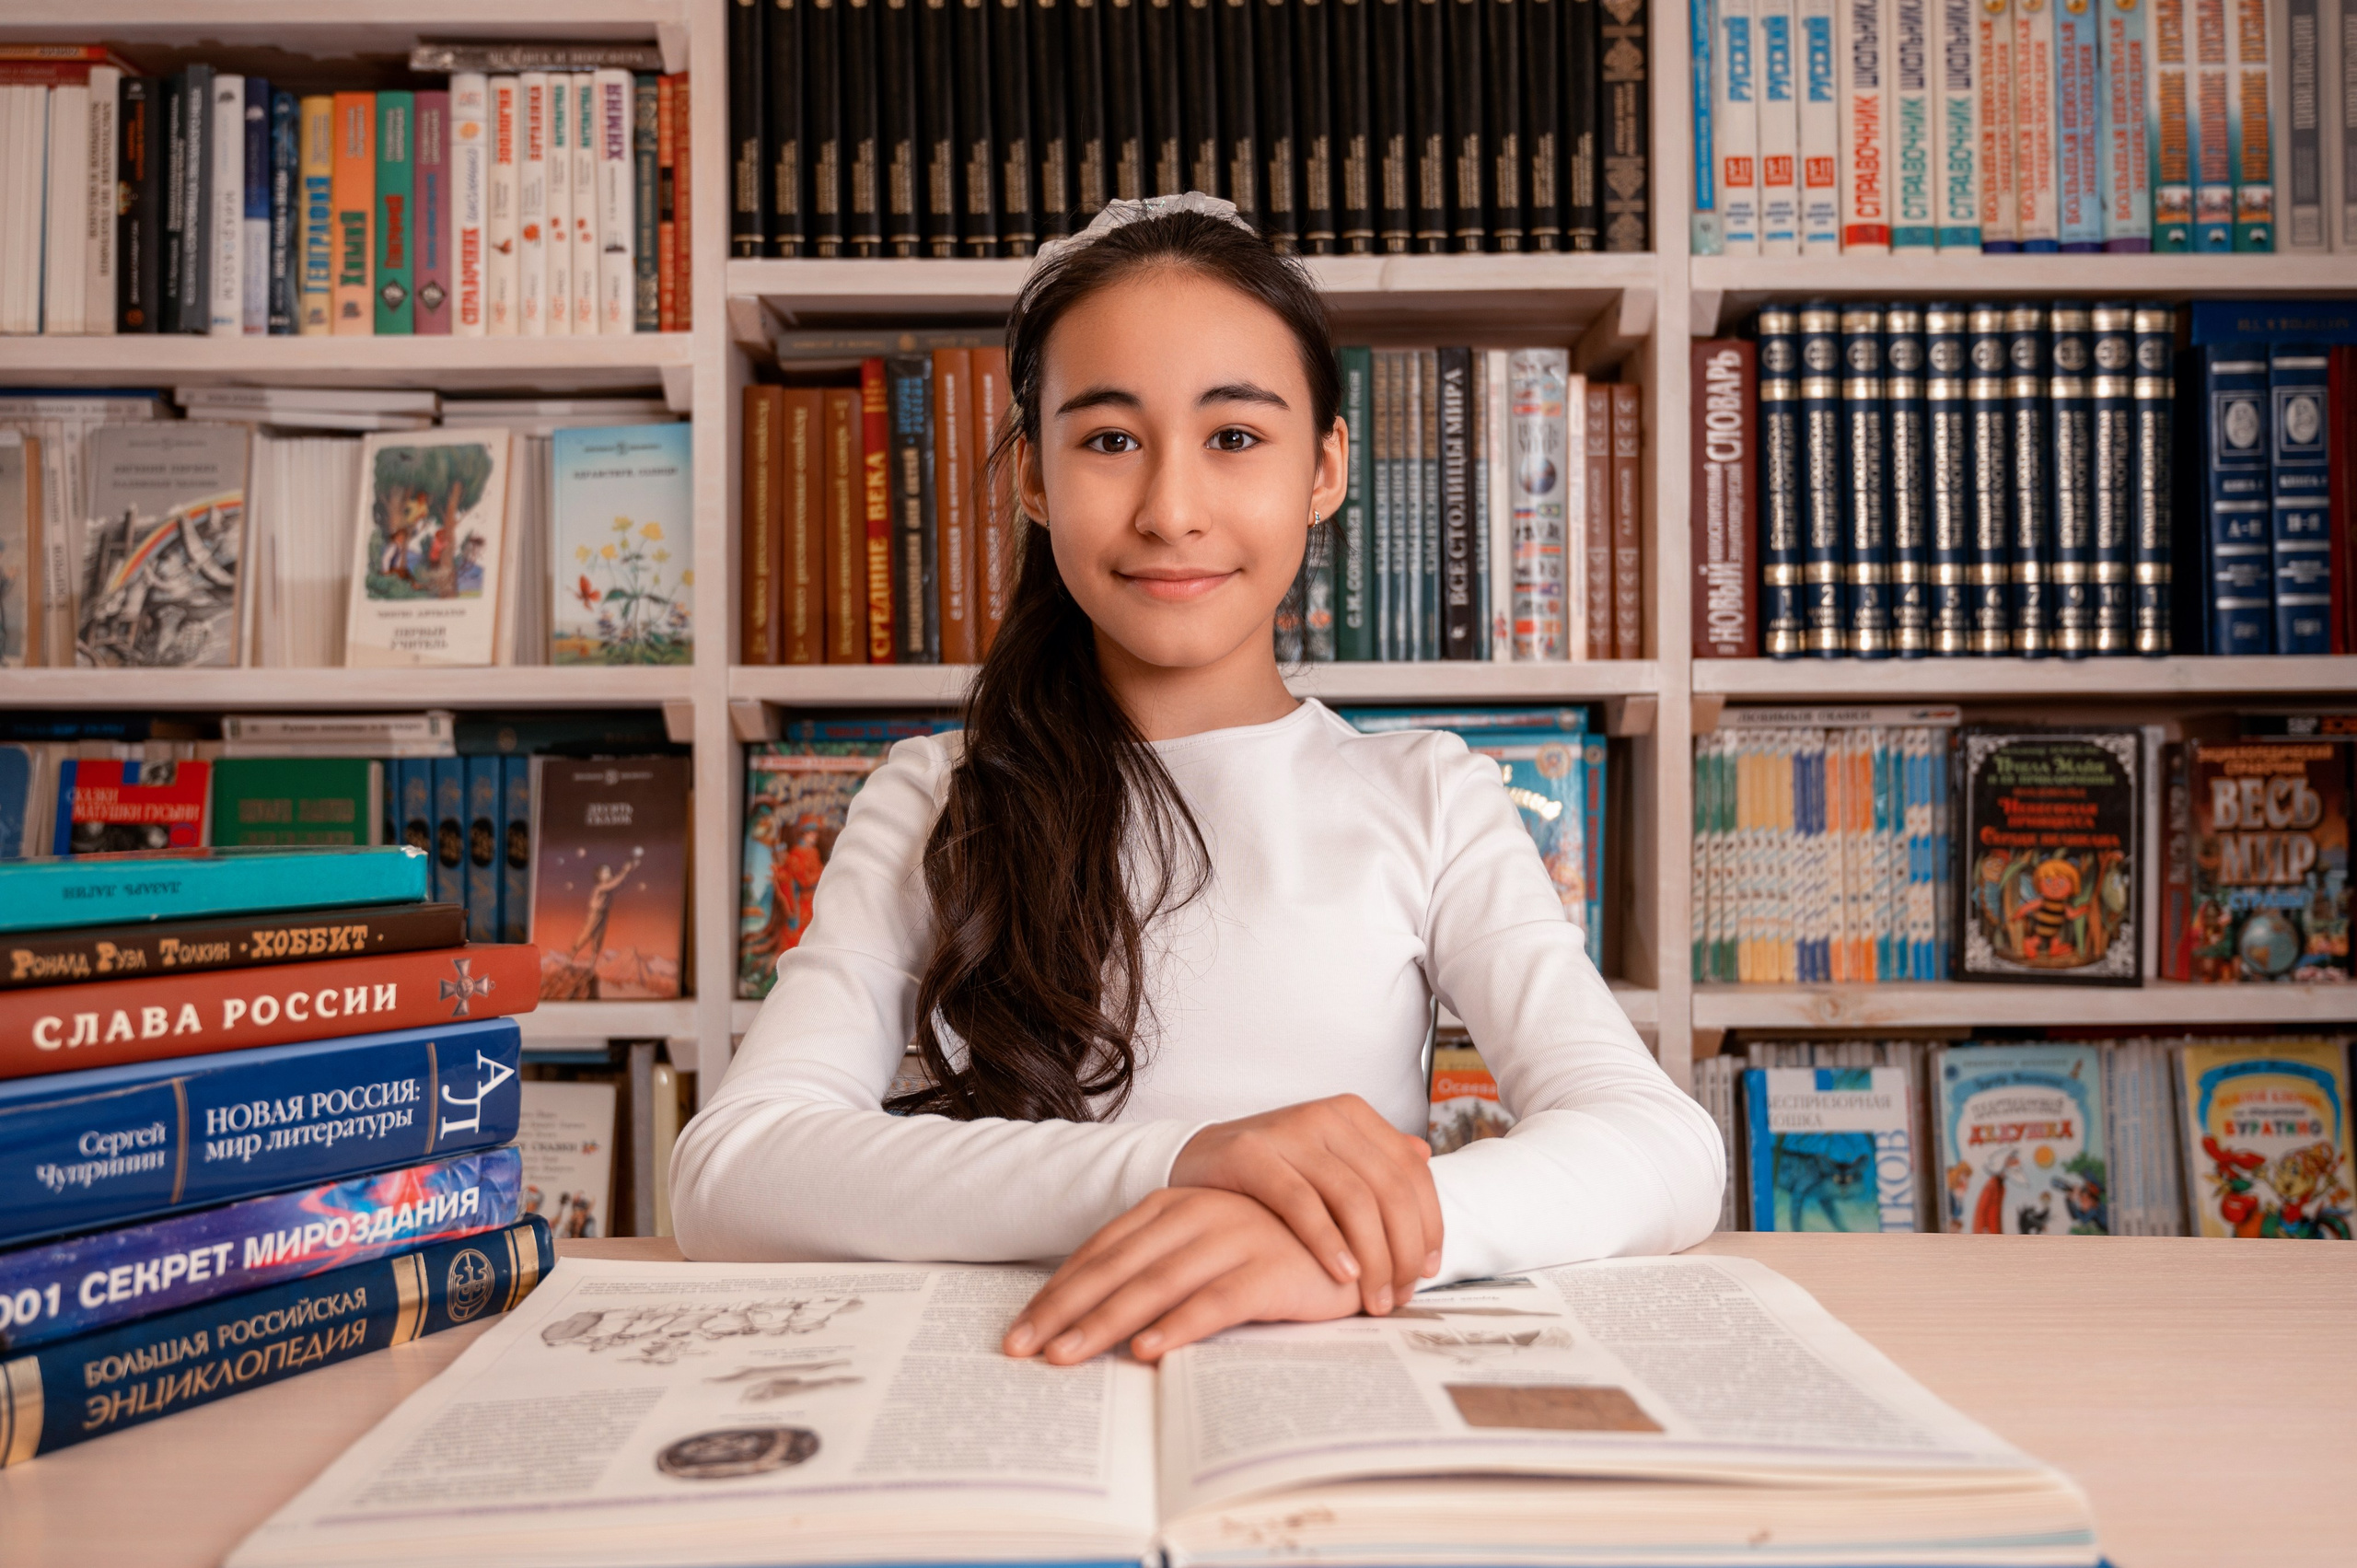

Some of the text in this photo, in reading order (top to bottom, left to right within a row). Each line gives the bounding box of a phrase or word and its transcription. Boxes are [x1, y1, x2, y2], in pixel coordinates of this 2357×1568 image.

[498, 87, 513, 166] ЗООЛОГИЯ
[528, 84, 543, 162] БОТАНИКА
[606, 83, 624, 163] ХИМИЯ
[1852, 0, 1881, 217] СПРАВОЧНИК ШКОЛЬНИК
[1898, 0, 1928, 220] СПРАВОЧНИК ШКОЛЬНИК
[1945, 0, 1974, 220] СПРАВОЧНИК ШКОЛЬНИК
[1979, 20, 1999, 223] БОЛЬШАЯ ШКОЛЬНАЯ
[2017, 18, 2036, 221] БОЛЬШАЯ ШКОЛЬНАЯ
[2061, 22, 2081, 226] БОЛЬШАЯ ШКОЛЬНАЯ
[2110, 18, 2131, 221] БОЛЬШАЯ ШКОЛЬНАЯ
[459, 226, 481, 327] СПРАВОЧНИК
[1443, 366, 1469, 607] ВСЕ СТОЛИЦЫ МИРА
[1700, 350, 1745, 645] НОВЫЙ СЛОВАРЬ
[864, 450, 892, 659] СРЕДНИЕ ВЕКА
[1781, 587, 1794, 608] 1
[1821, 583, 1837, 607] 2
[1904, 587, 1920, 606] 4
[1945, 587, 1960, 608] 5
[1986, 587, 2001, 608] 6
[2027, 585, 2041, 607] 7
[2068, 587, 2084, 608] 9
[2101, 586, 2126, 608] 10
[74, 802, 142, 821] МАТУШКИ
[2210, 776, 2323, 831] ВЕСЬ
[2218, 830, 2317, 887] МИР
[62, 881, 182, 900] ЛАЗАРЬ ЛАГИН
[250, 924, 370, 958] ХОББИТ
[31, 982, 399, 1051] СЛАВА РОССИИ
[204, 1107, 414, 1165] мир литературы
[205, 1077, 423, 1136] НОВАЯ РОССИЯ:
[1968, 1119, 2075, 1147] ДЕДУШКА
[2223, 1119, 2324, 1139] БУРАТИНО
[78, 1121, 168, 1157] Сергей
[36, 1150, 167, 1194] Чупринин
[78, 1241, 235, 1309] СЕКРЕТ
[243, 1185, 482, 1270] МИРОЗДАНИЯ
[82, 1286, 369, 1390] БОЛЬШАЯ РОССИЙСКАЯ
[82, 1318, 368, 1432] ЭНЦИКЛОПЕДИЯ
